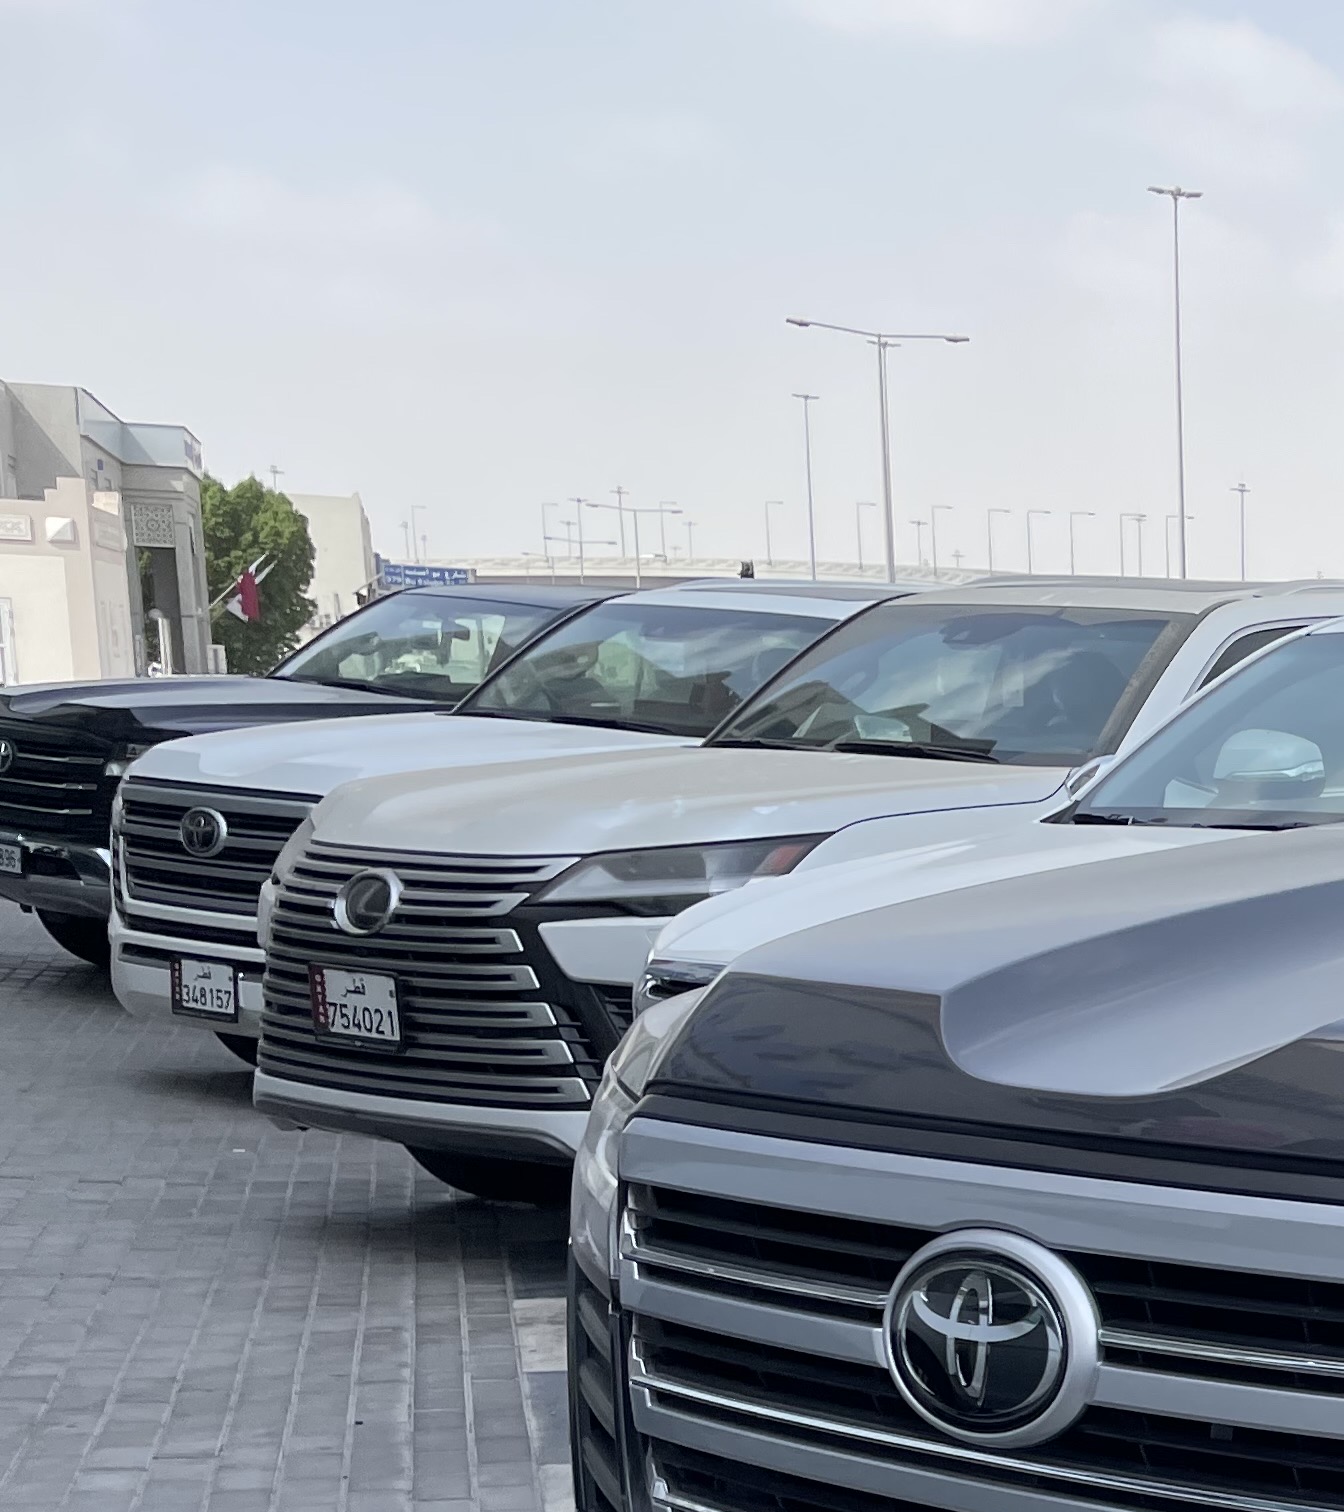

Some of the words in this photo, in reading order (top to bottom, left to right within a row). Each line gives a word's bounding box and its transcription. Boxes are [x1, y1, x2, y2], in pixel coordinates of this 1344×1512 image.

[182, 984, 232, 1010] 348157
[341, 977, 366, 998] قطر
[327, 1001, 395, 1037] 754021
